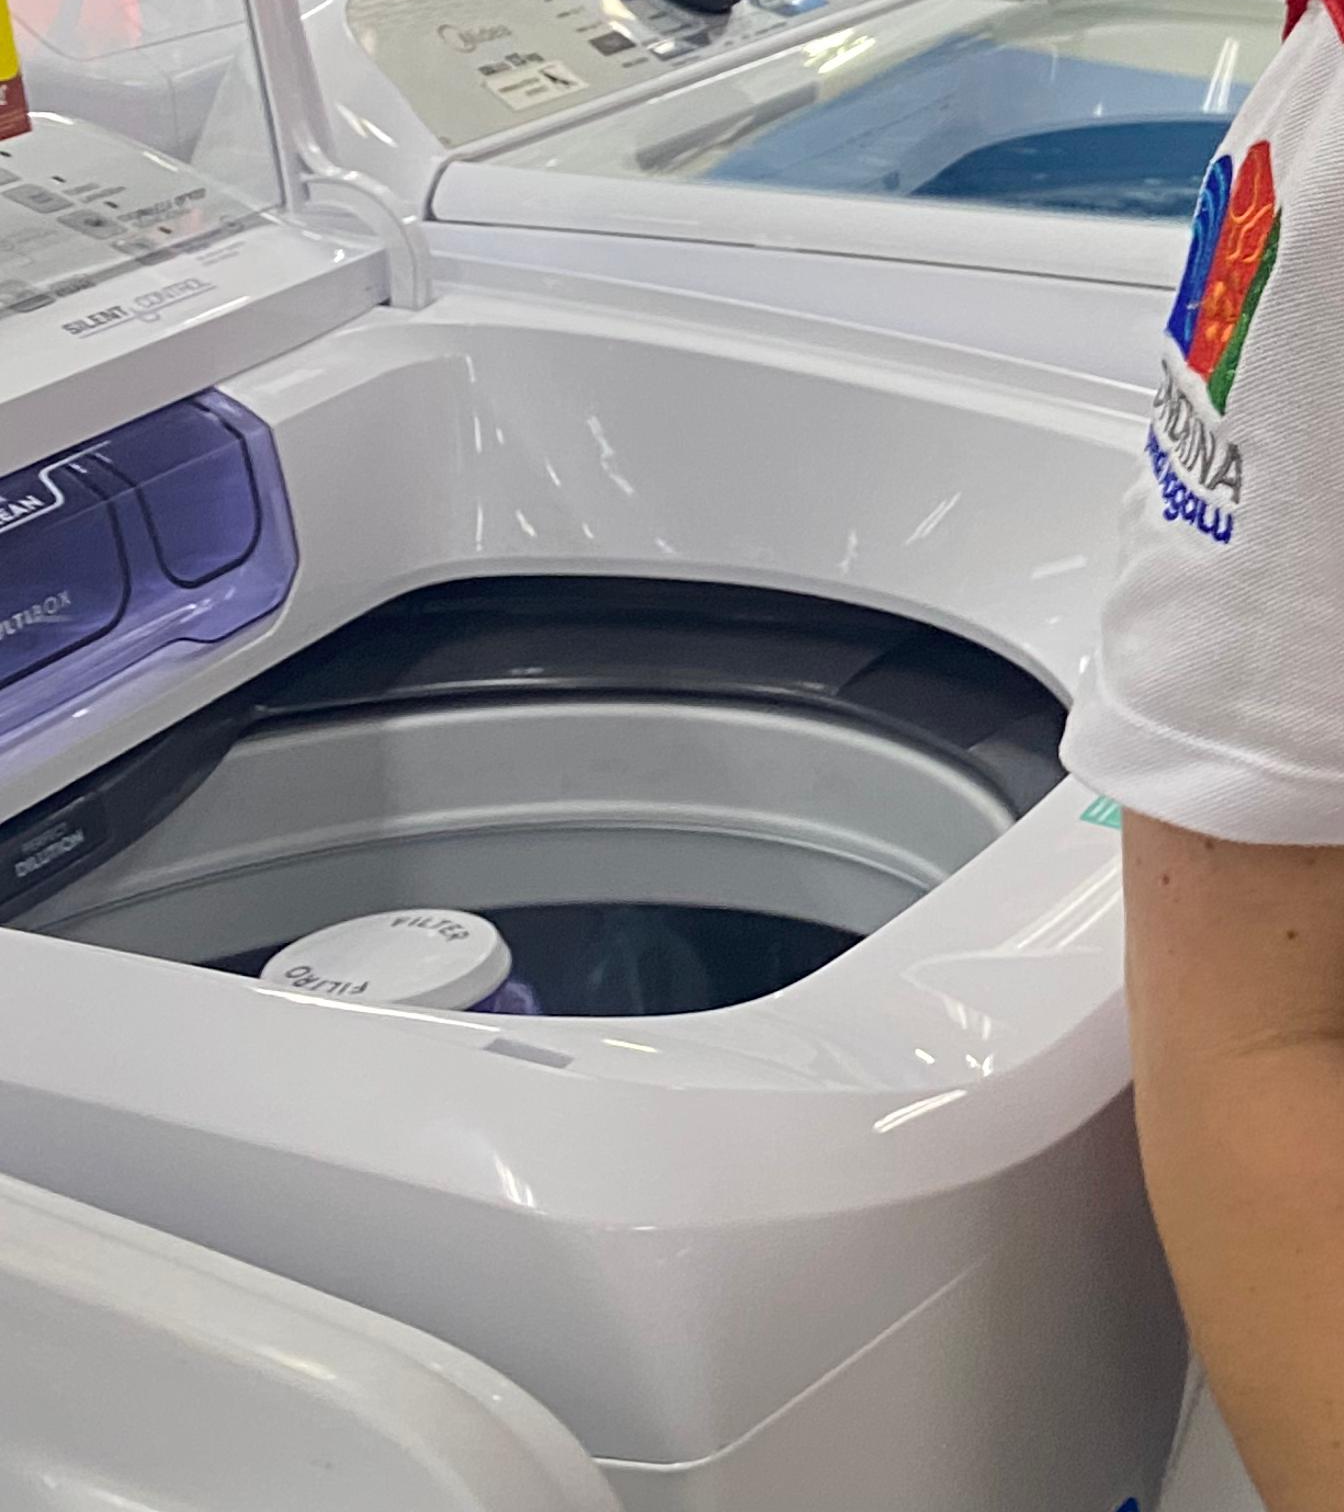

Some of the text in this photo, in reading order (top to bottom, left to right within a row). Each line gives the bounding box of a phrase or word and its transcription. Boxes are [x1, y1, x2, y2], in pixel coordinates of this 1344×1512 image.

[61, 305, 129, 335] SILENT
[0, 495, 45, 525] EAN
[391, 915, 470, 943] FILTER
[285, 965, 369, 996] FILTRO
